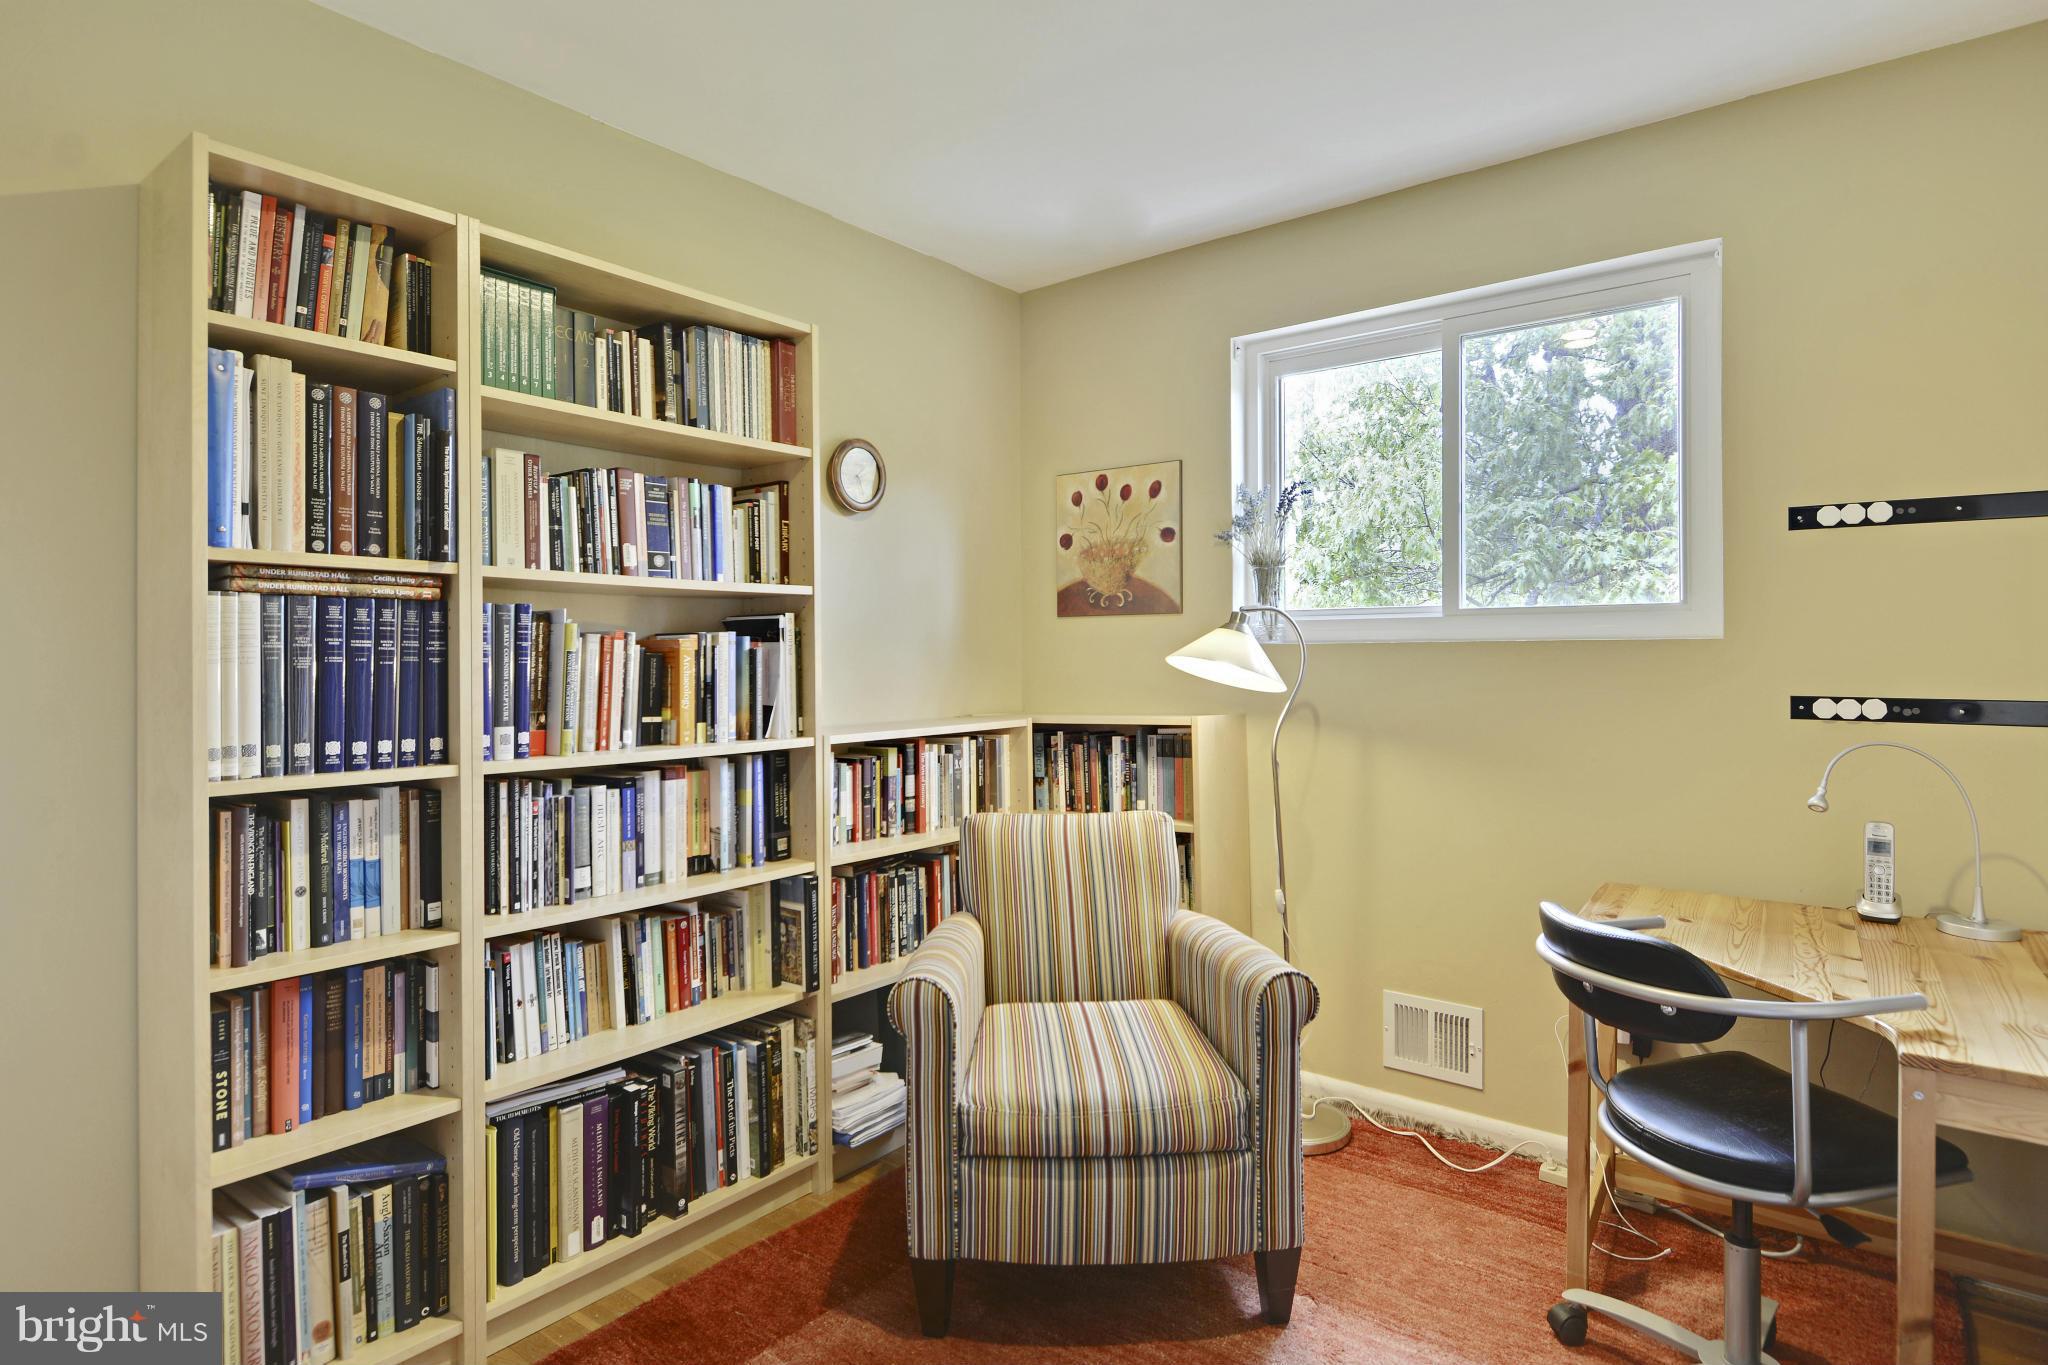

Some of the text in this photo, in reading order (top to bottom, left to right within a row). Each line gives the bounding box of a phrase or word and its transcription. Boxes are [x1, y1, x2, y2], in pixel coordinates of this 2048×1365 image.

[273, 215, 287, 262] BESTIARY
[245, 215, 258, 299] PRIDE AND PRODIGIES
[583, 358, 589, 367] 2
[258, 582, 285, 590] UNDER
[373, 575, 415, 584] Cecilia Ljung
[372, 588, 395, 596] Cecilia
[682, 655, 692, 711] Archaeology
[1036, 745, 1044, 772] Opera
[216, 1071, 227, 1121] STONE
[726, 1079, 734, 1097] The
[647, 1103, 655, 1125] Viking
[728, 1112, 734, 1121] of
[648, 1126, 656, 1151] World
[512, 1162, 520, 1185] religion
[512, 1195, 520, 1224] long-term
[380, 1193, 392, 1256] Anglo-Saxon
